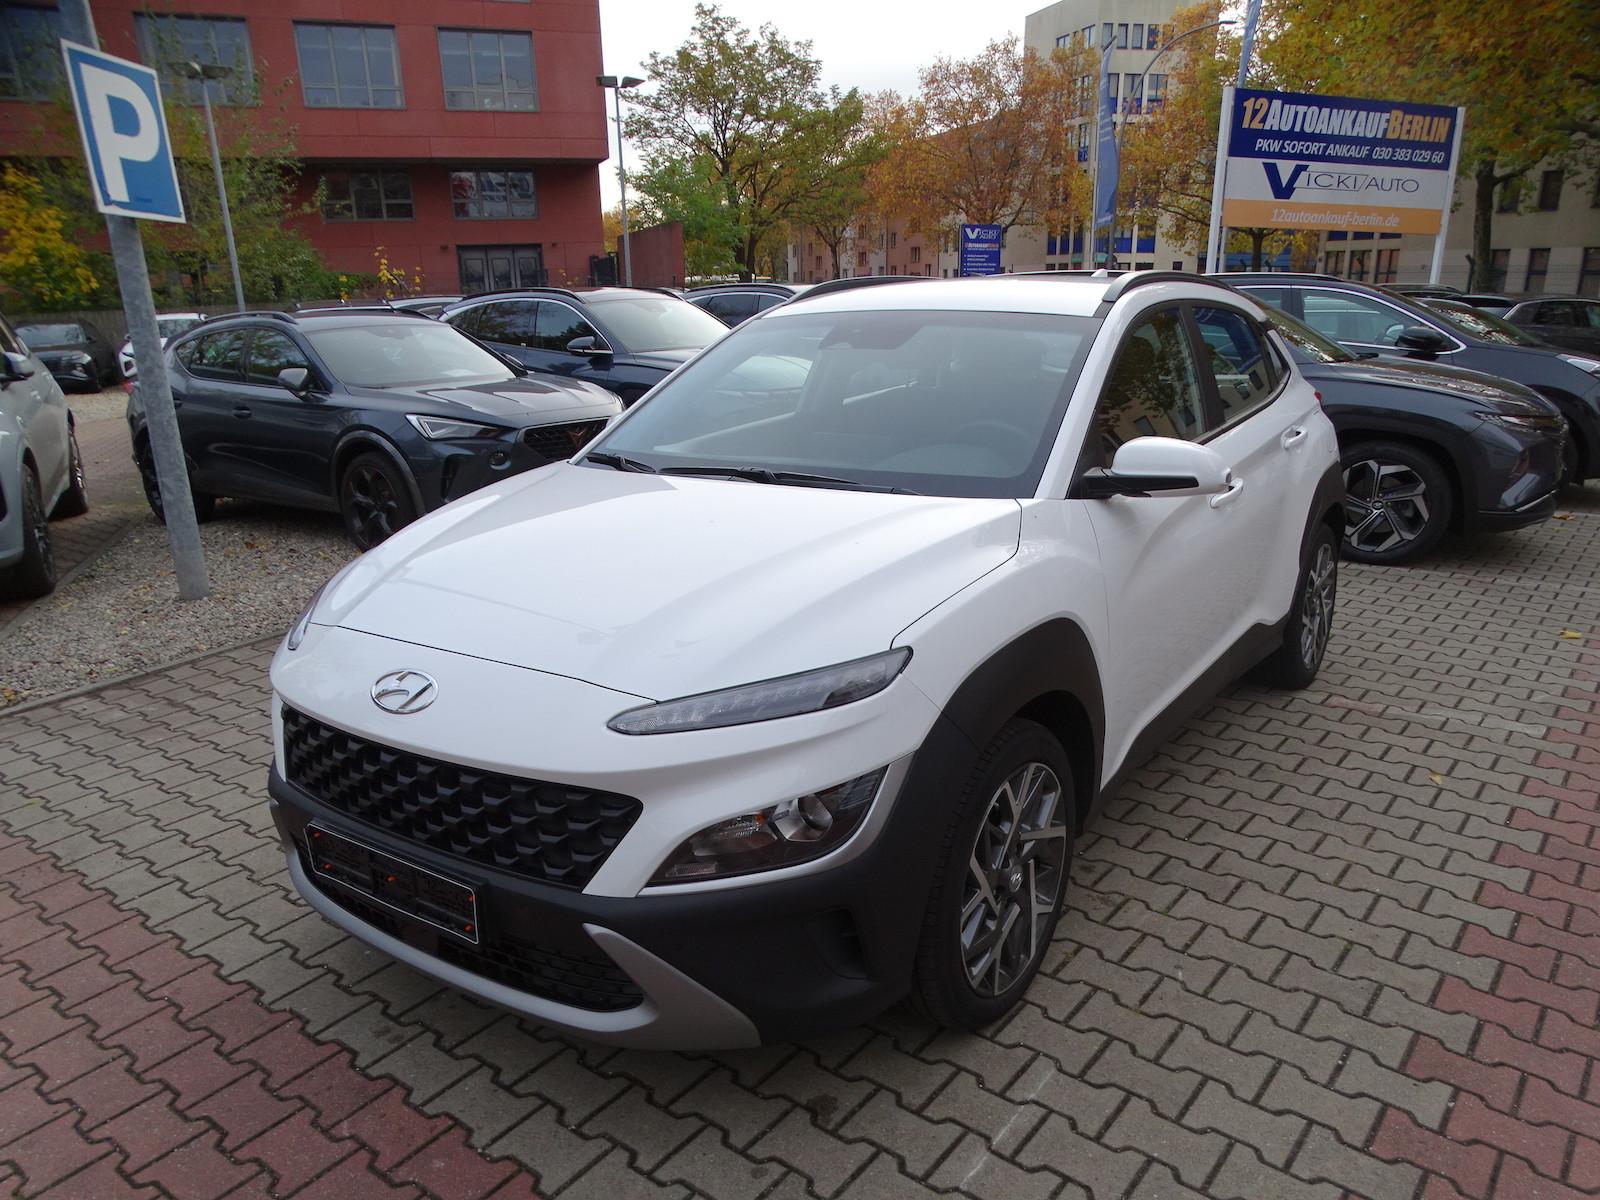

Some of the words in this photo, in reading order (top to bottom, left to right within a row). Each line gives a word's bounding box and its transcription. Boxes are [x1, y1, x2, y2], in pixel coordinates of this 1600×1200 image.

[80, 62, 160, 203] P
[1255, 139, 1282, 153] PKW
[1282, 140, 1326, 156] SOFORT
[1325, 143, 1370, 158] ANKAUF
[1372, 146, 1392, 160] 030
[1392, 148, 1411, 161] 383
[1412, 150, 1431, 162] 029
[1431, 151, 1445, 163] 60
[1270, 208, 1399, 228] 12autoankauf-berlin.de
